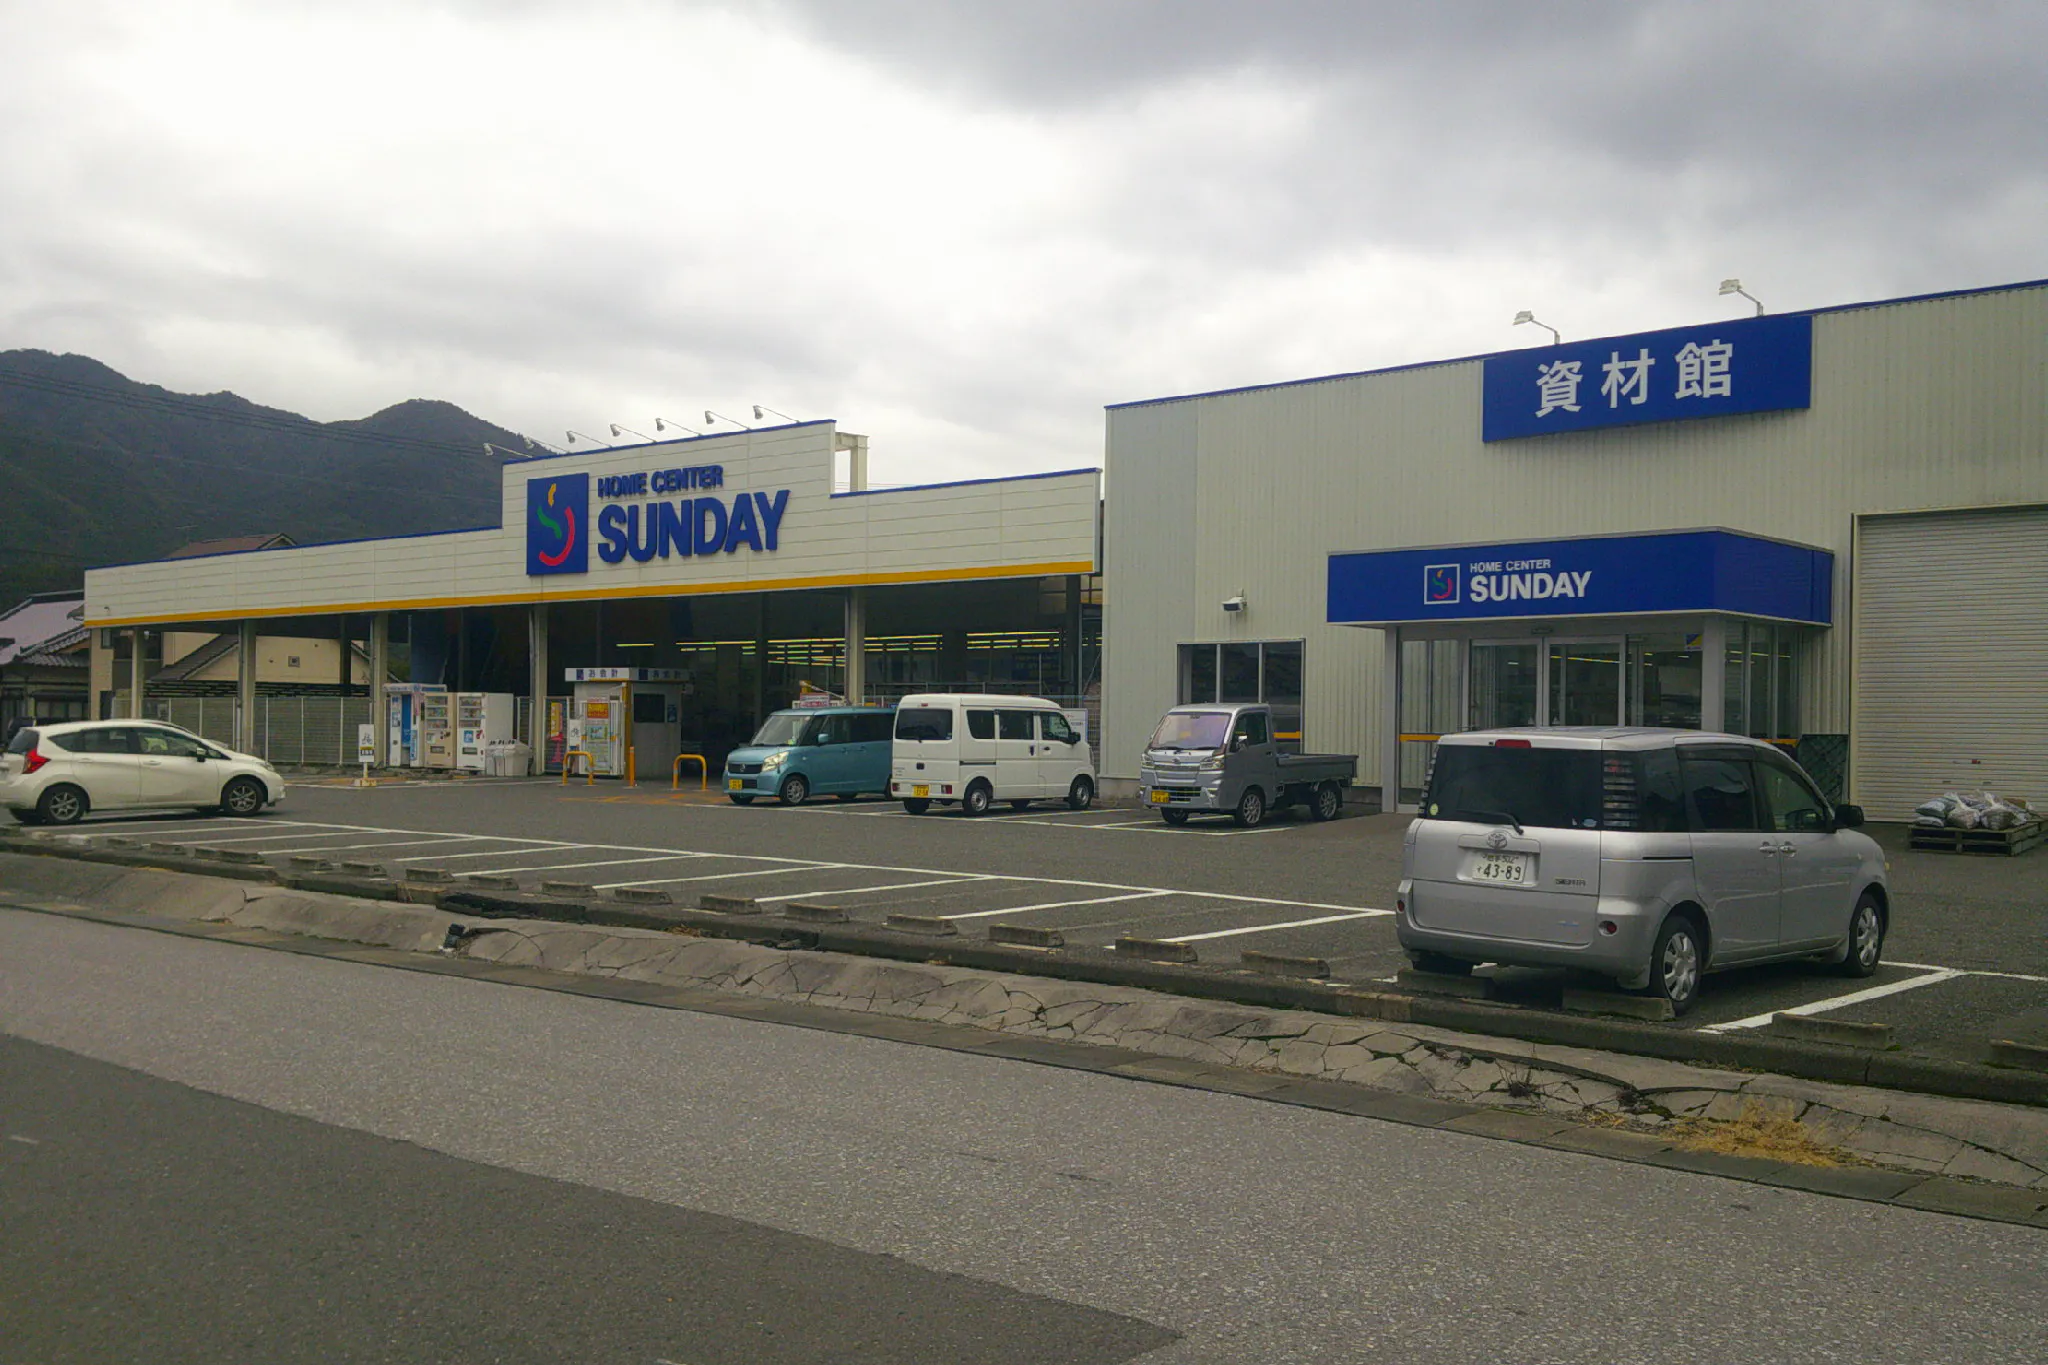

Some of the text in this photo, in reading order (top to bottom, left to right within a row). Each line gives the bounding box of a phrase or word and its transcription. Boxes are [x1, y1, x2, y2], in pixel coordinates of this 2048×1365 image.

[1535, 339, 1733, 418] 資材館
[597, 465, 723, 498] HOME CENTER
[598, 490, 790, 563] SUNDAY
[1470, 559, 1551, 573] HOME CENTER
[1470, 571, 1592, 602] SUNDAY
[1483, 863, 1521, 880] 43-89
